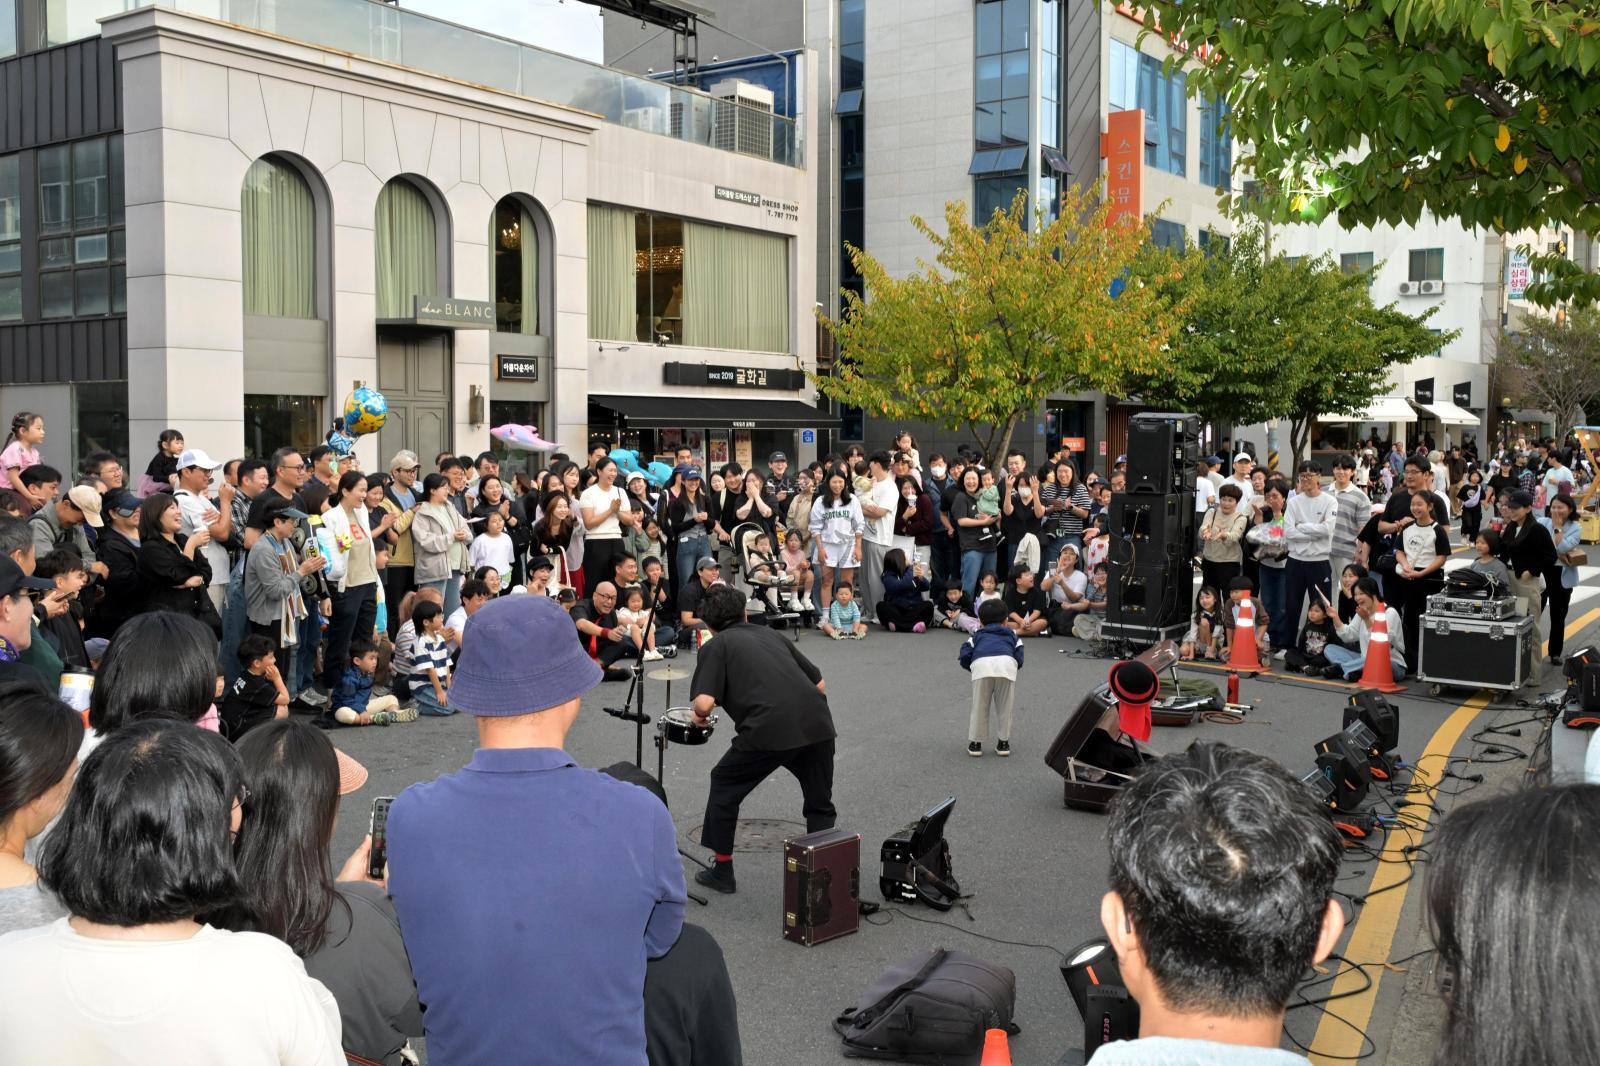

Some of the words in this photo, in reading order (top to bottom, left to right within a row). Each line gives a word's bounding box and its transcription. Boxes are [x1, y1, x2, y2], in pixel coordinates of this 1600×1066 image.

[761, 199, 781, 209] DRESS
[782, 204, 799, 212] SHOP
[1511, 268, 1528, 278] 심리
[1510, 279, 1528, 288] 상담
[445, 303, 493, 319] BLANC
[708, 372, 721, 380] SINCE
[721, 371, 734, 381] 2019
[736, 368, 767, 385] 굴화길
